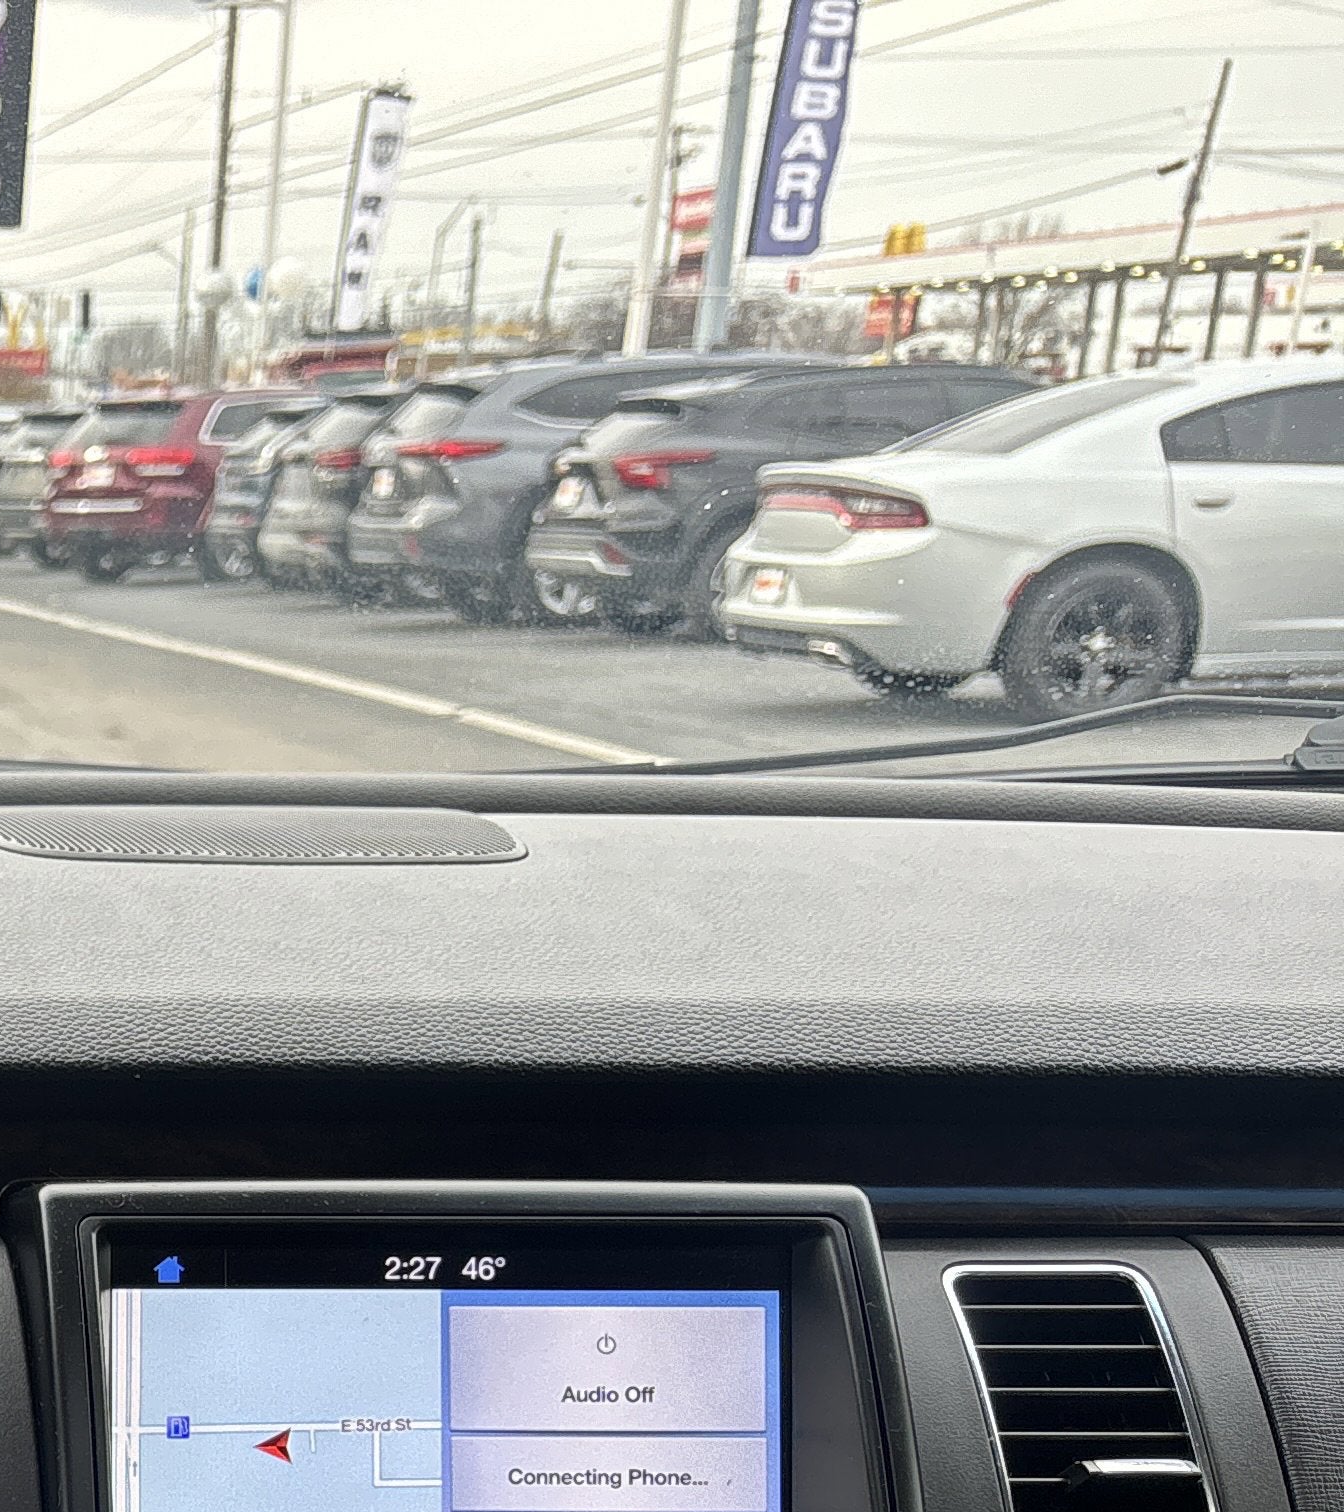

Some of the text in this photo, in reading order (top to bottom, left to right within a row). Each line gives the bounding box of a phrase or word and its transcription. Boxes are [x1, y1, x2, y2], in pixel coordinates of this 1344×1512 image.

[768, 0, 858, 242] SUBARU
[385, 1257, 505, 1280] 2:27 46°
[561, 1386, 655, 1402] Audio Off
[340, 1414, 413, 1433] E 53rd St
[509, 1469, 708, 1489] Connecting Phone...
